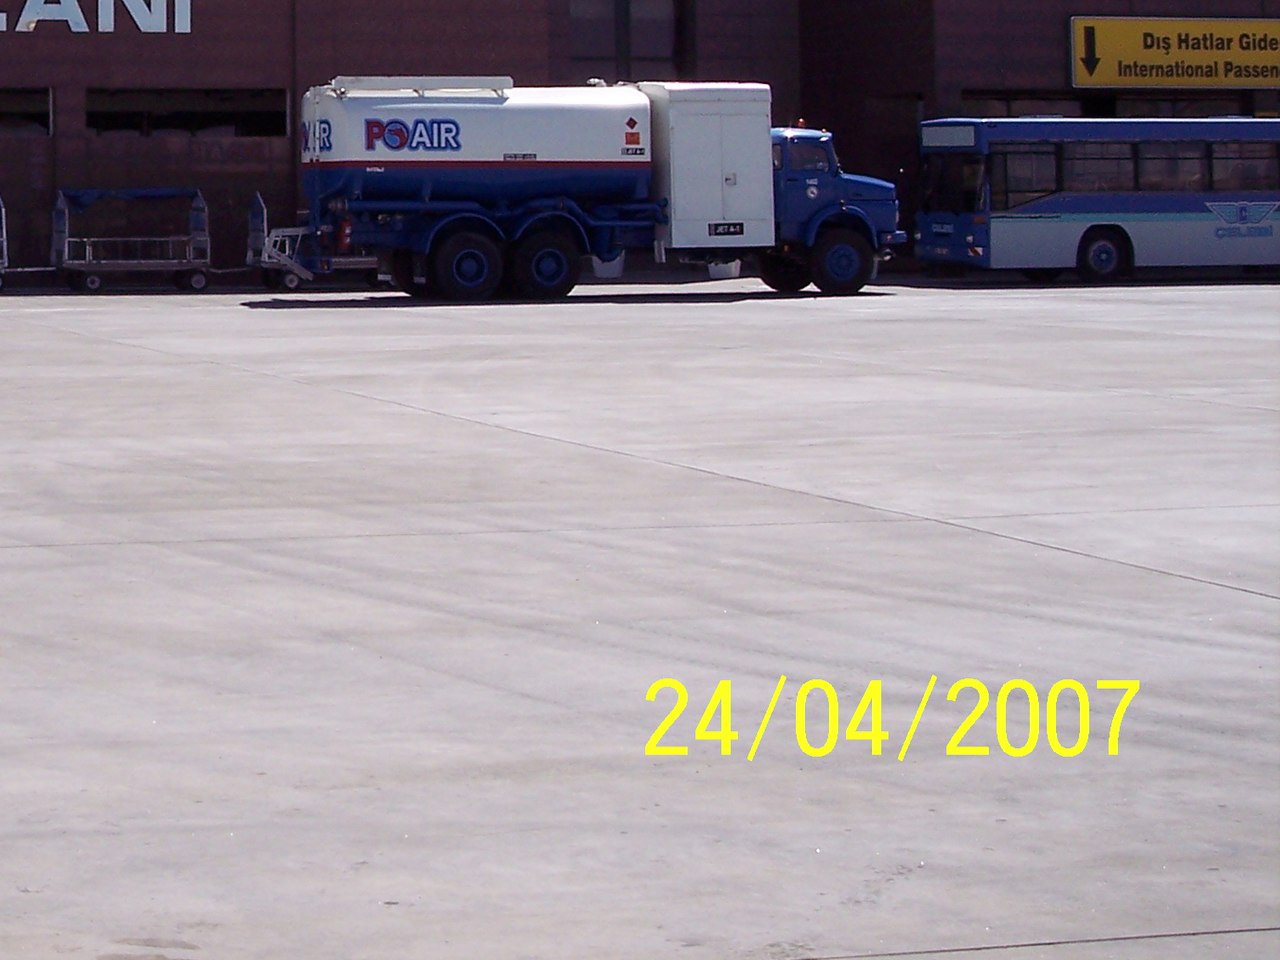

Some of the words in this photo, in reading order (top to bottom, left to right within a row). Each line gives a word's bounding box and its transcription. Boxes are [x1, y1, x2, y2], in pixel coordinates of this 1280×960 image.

[1143, 32, 1172, 56] Dış
[1177, 33, 1234, 51] Hatlar
[1238, 33, 1280, 52] Gide
[1118, 60, 1220, 78] International
[1224, 61, 1280, 79] Passen
